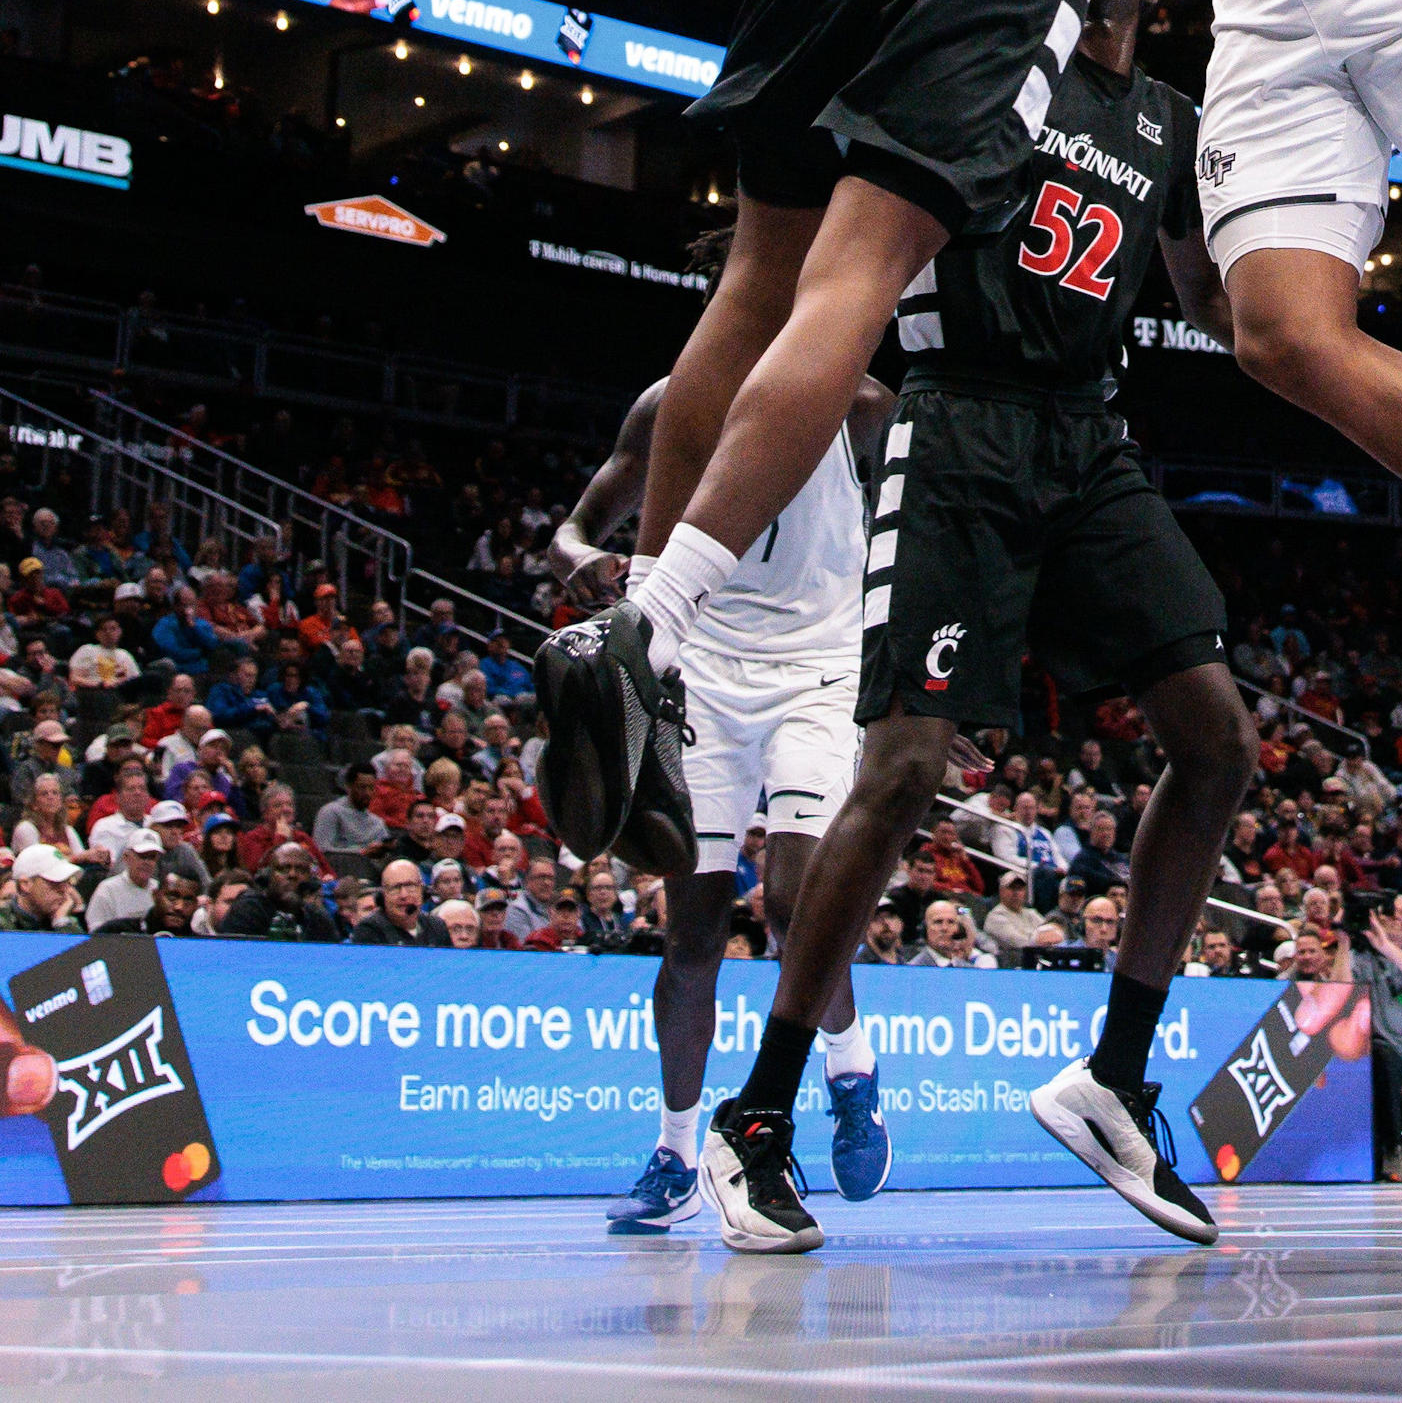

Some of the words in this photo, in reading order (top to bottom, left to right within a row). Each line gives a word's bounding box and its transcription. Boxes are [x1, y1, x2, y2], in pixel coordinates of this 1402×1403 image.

[625, 40, 720, 87] venmo
[1034, 125, 1153, 202] CINCINNATI
[334, 205, 416, 237] SERVPRO
[1018, 180, 1123, 302] 52
[25, 987, 79, 1024] venmo
[246, 979, 421, 1048] Score
[435, 1002, 572, 1051] more
[586, 992, 660, 1051] wit
[964, 1000, 1081, 1059] Debit
[58, 1005, 186, 1151] XII
[400, 1074, 469, 1112] Earn
[477, 1076, 621, 1123] always-on
[916, 1082, 987, 1113] Stash
